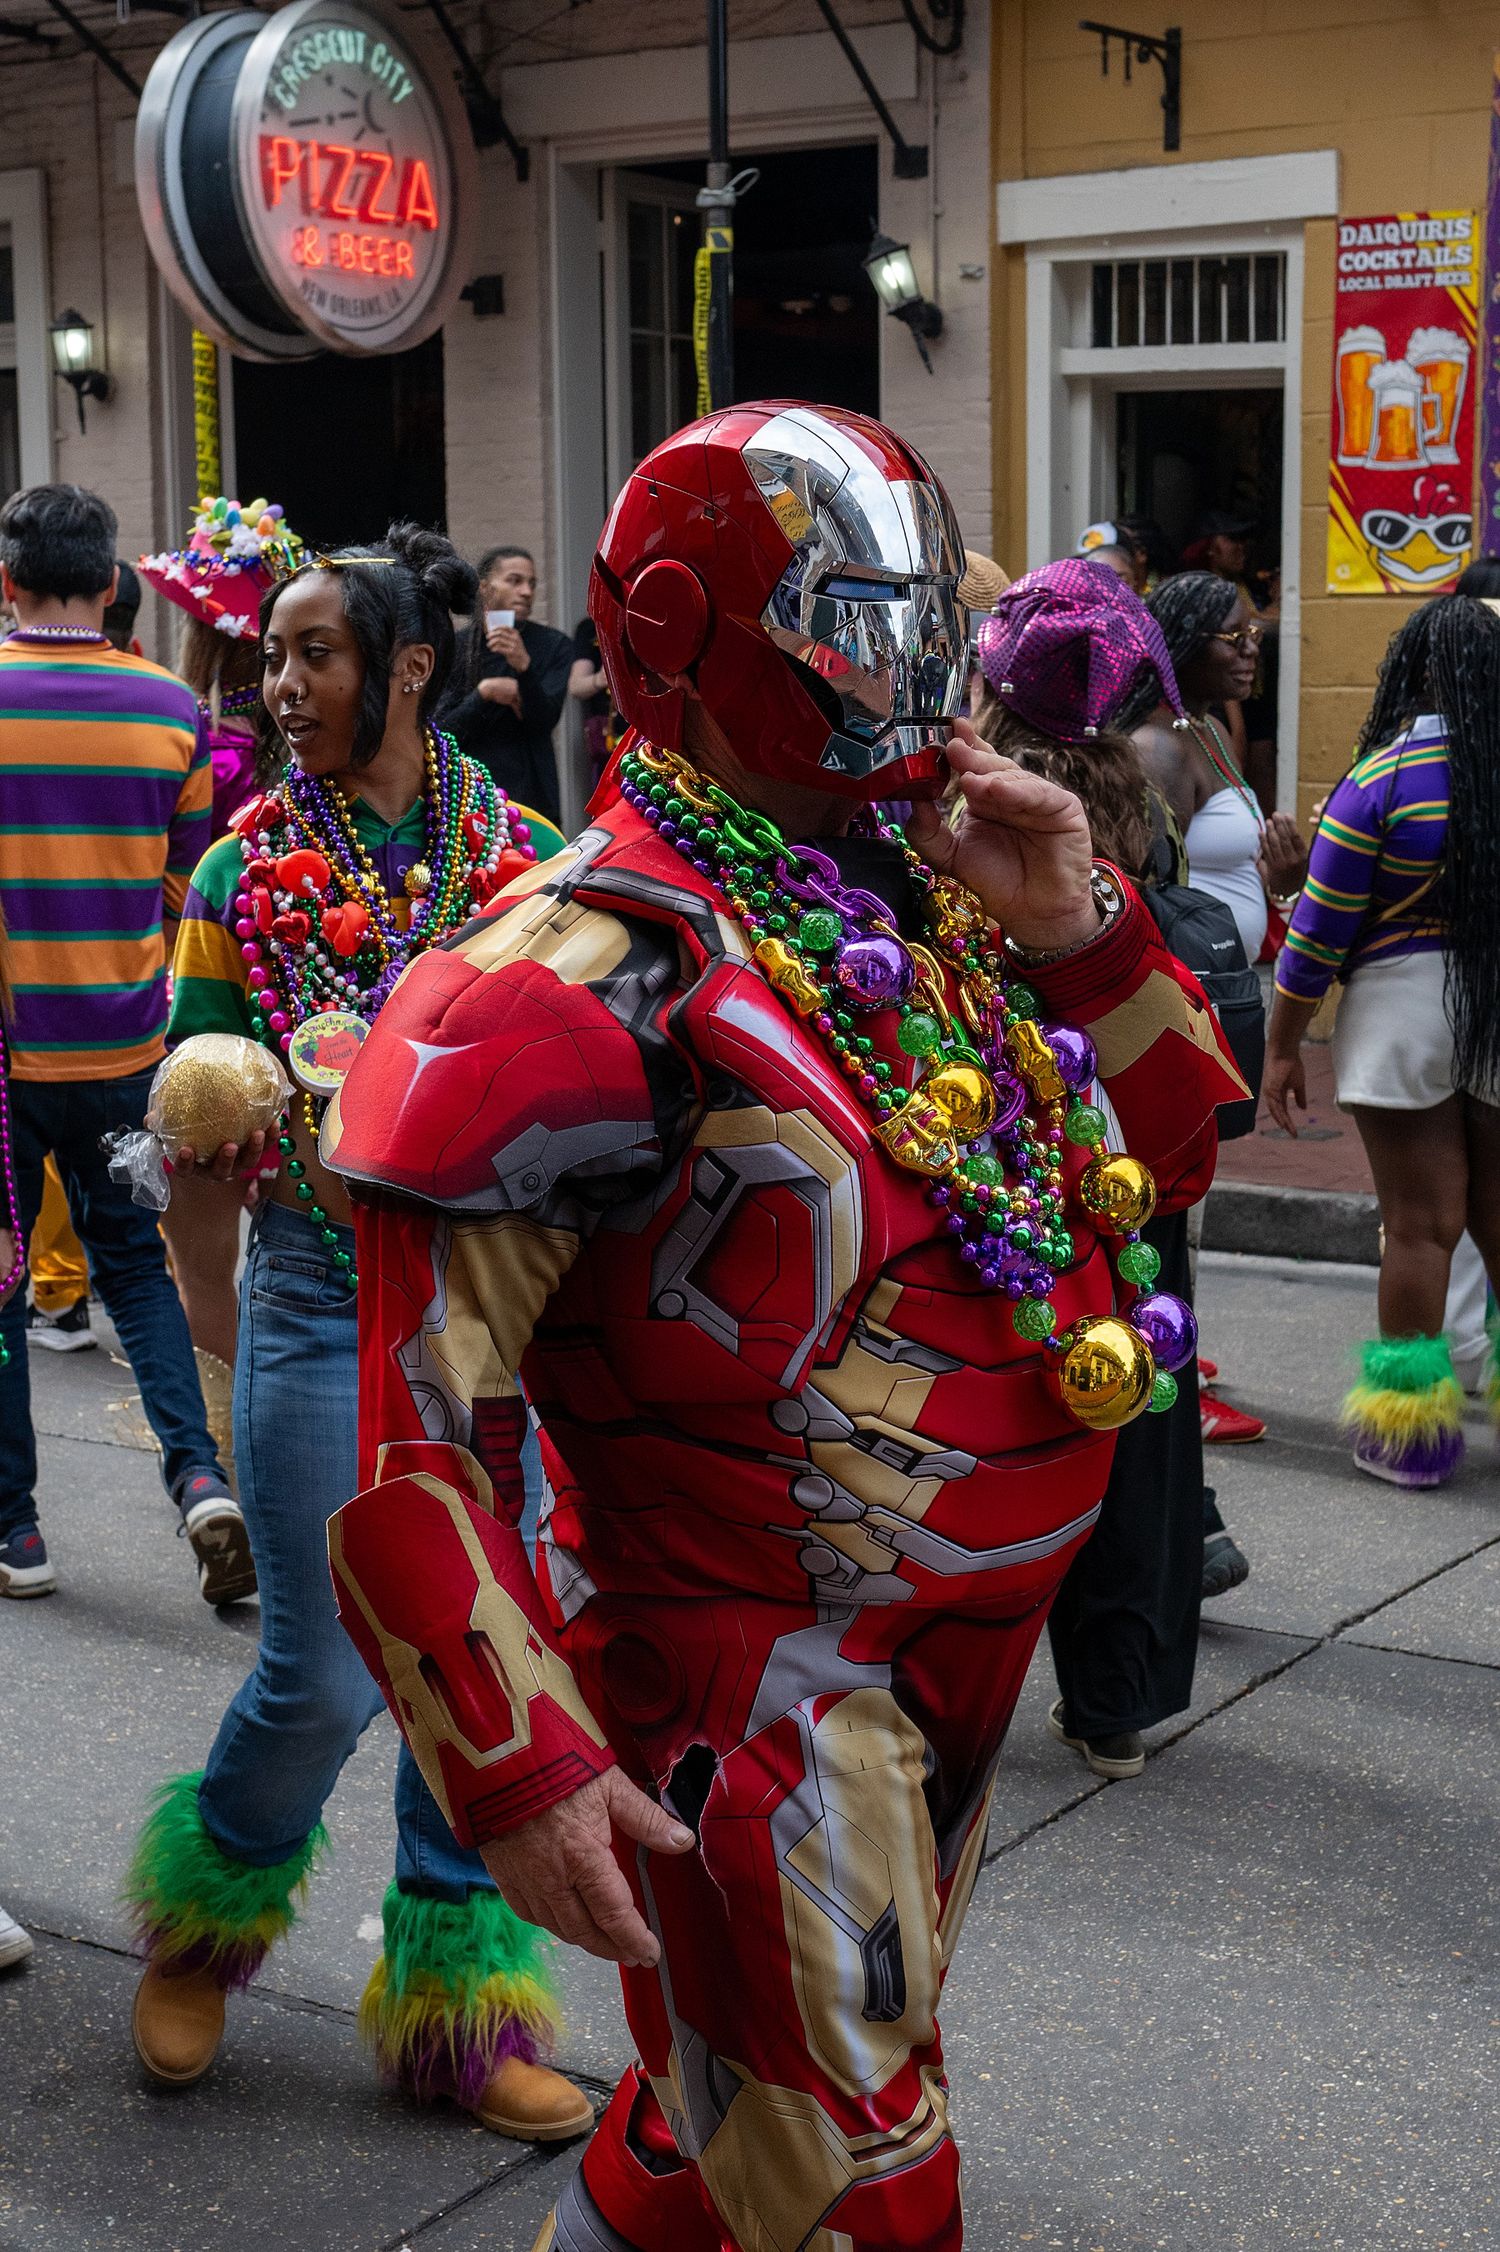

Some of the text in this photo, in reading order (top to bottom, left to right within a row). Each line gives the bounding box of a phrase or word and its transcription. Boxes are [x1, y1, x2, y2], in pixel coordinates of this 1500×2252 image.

[370, 42, 414, 103] CITY
[260, 134, 438, 230] PIZZA
[1339, 217, 1472, 247] DAIQUIRIS
[296, 225, 415, 279] & BEER
[1339, 244, 1472, 272] COCKTAILS
[1338, 270, 1471, 292] LOCAL DRAFT BEER
[325, 1047, 353, 1066] Heart
